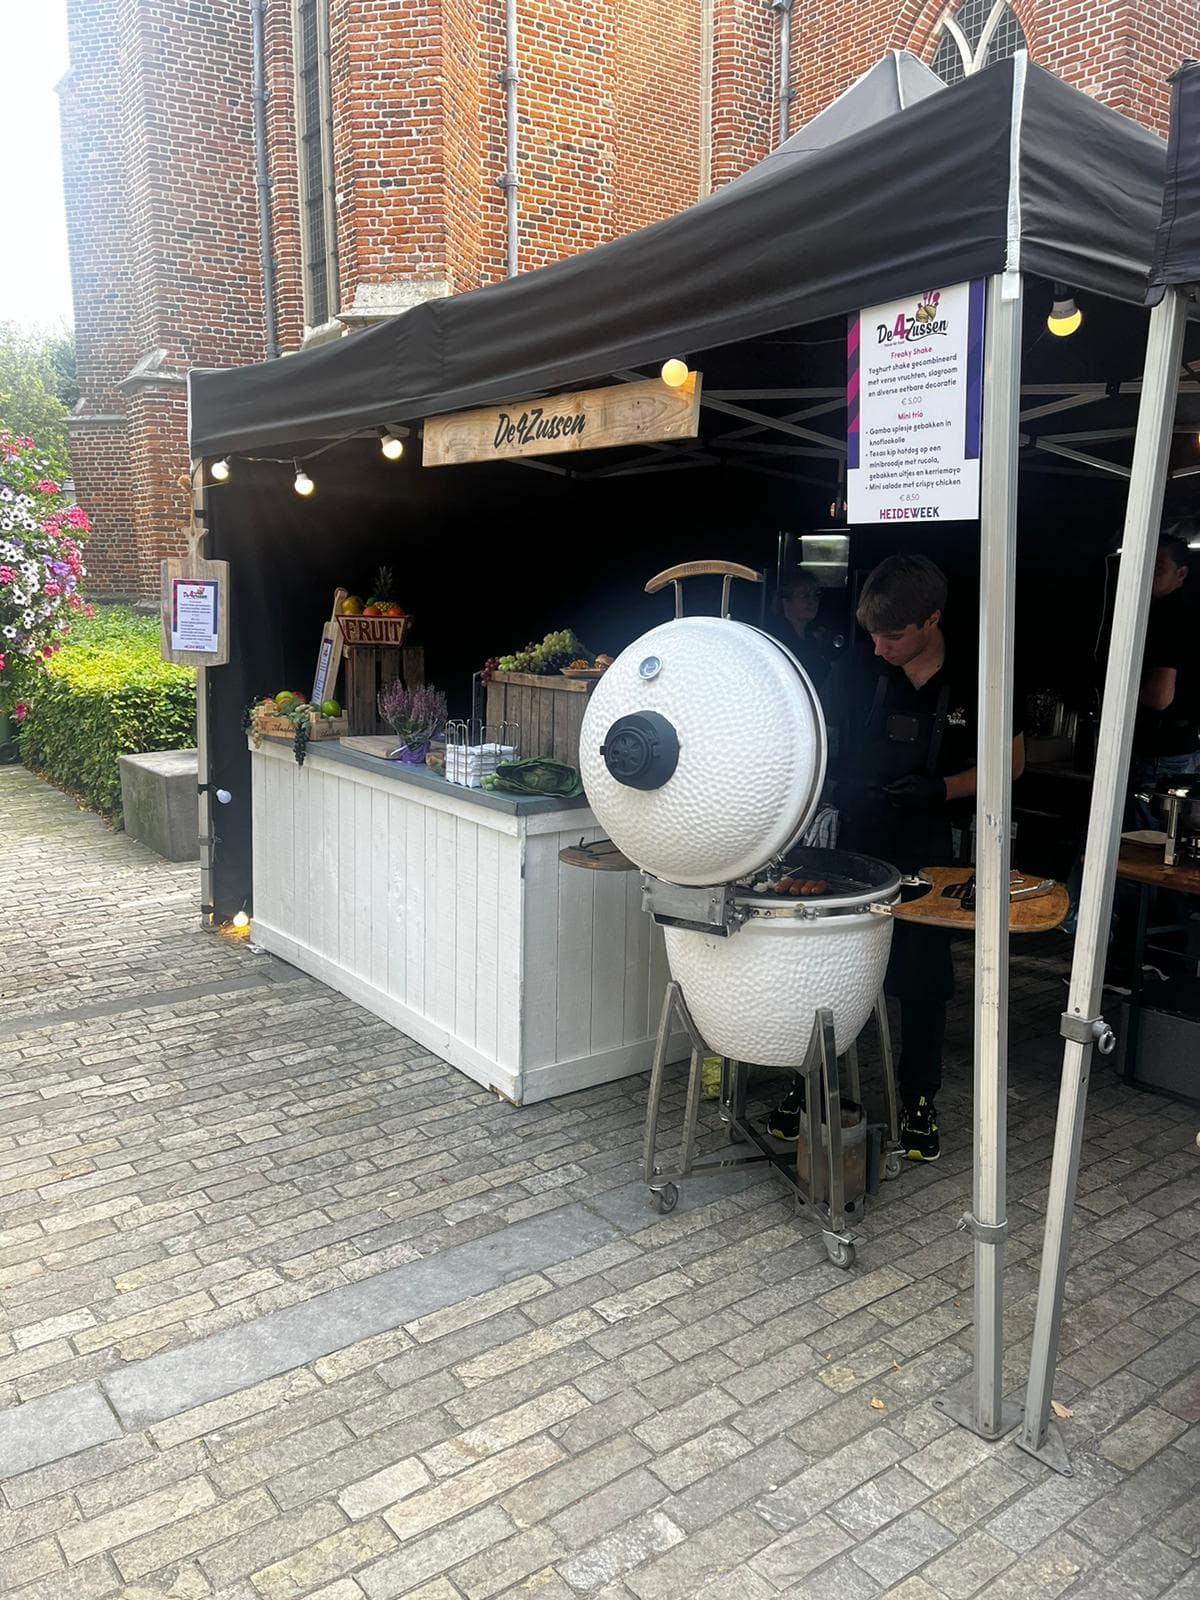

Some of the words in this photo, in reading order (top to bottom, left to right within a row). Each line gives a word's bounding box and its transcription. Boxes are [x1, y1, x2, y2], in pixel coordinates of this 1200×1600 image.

[890, 351, 912, 360] Freaky
[913, 346, 933, 355] Shake
[868, 366, 892, 376] Yoghurt
[892, 362, 911, 371] shake
[911, 354, 957, 369] gecombineerd
[880, 376, 897, 384] verse
[897, 370, 928, 382] vruchten,
[928, 367, 958, 378] slagroom
[876, 386, 898, 396] diverse
[899, 382, 924, 393] eetbare
[924, 377, 957, 390] decoratie
[912, 410, 924, 419] trio
[869, 427, 891, 435] Gamba
[891, 423, 912, 435] spiesje
[913, 420, 945, 431] gebakken
[945, 419, 952, 427] in
[869, 437, 905, 446] knoflookolie
[869, 450, 886, 458] Texas
[887, 448, 896, 457] kip
[897, 447, 919, 455] hotdog
[919, 446, 929, 454] op
[869, 459, 904, 469] minibroodje
[917, 456, 940, 465] rucola,
[869, 472, 898, 481] gebakken
[898, 469, 915, 479] uitjes
[925, 466, 961, 476] kerriemayo
[868, 483, 881, 491] Mini
[882, 482, 901, 490] salade
[902, 480, 915, 488] met
[915, 479, 934, 489] crispy
[935, 478, 961, 486] chicken
[879, 506, 940, 519] HEIDEWEEK
[344, 620, 402, 641] FRUIT
